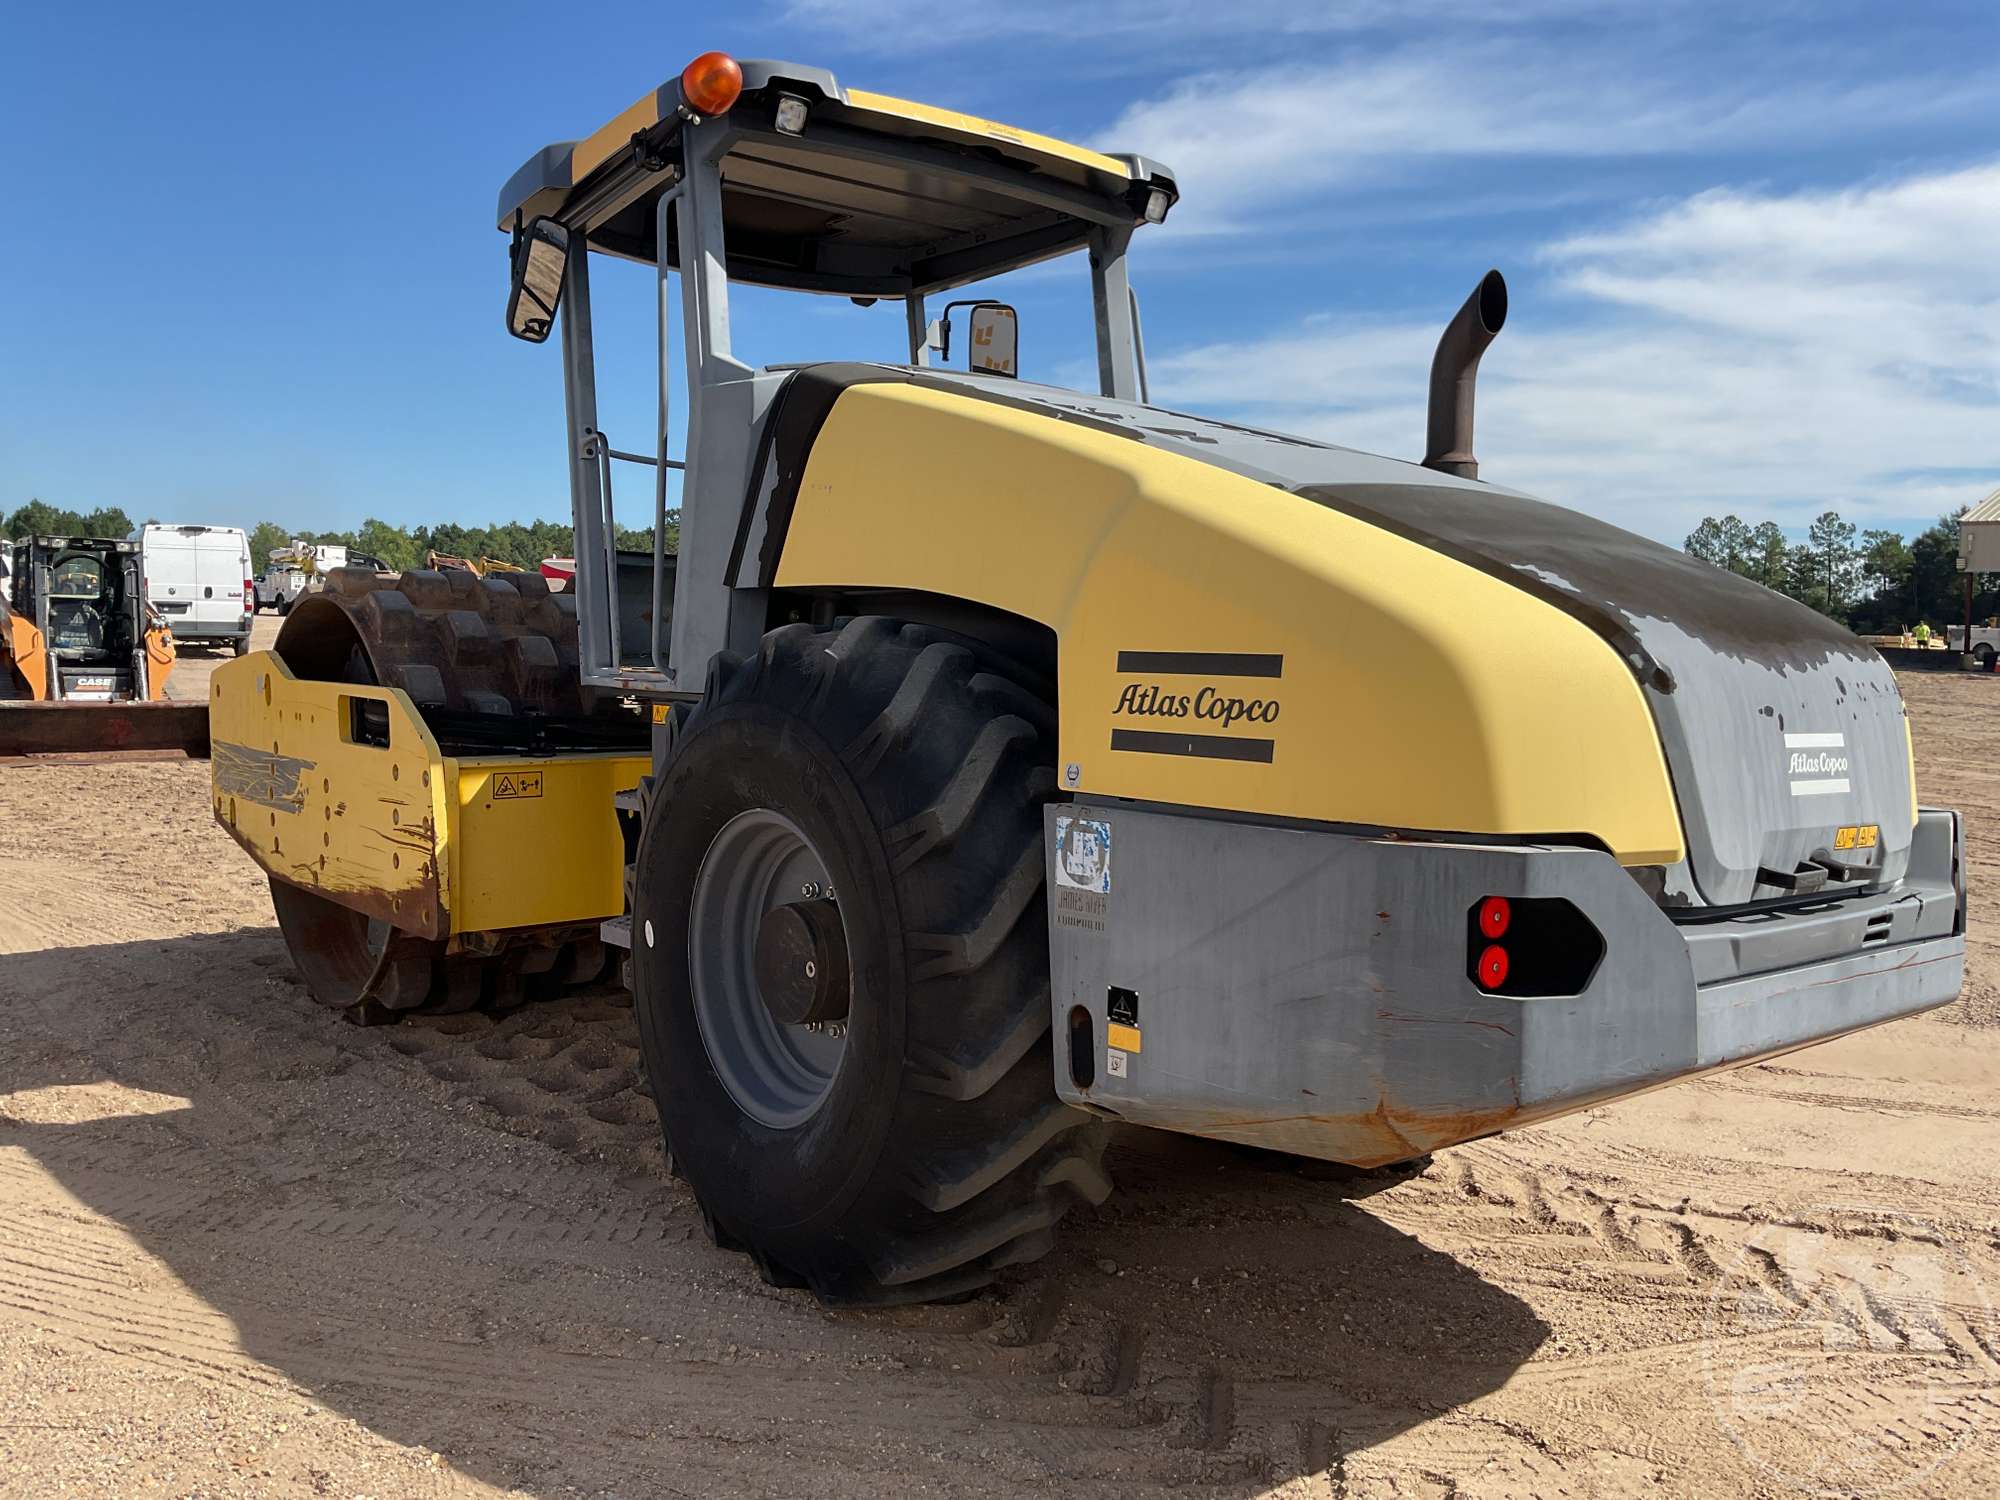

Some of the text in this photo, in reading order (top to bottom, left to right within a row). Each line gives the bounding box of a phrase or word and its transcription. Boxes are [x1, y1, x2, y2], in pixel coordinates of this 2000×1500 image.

[77, 678, 113, 686] CASE
[1112, 683, 1280, 728] Atlas Copco
[1788, 752, 1848, 776] Atlas Copco
